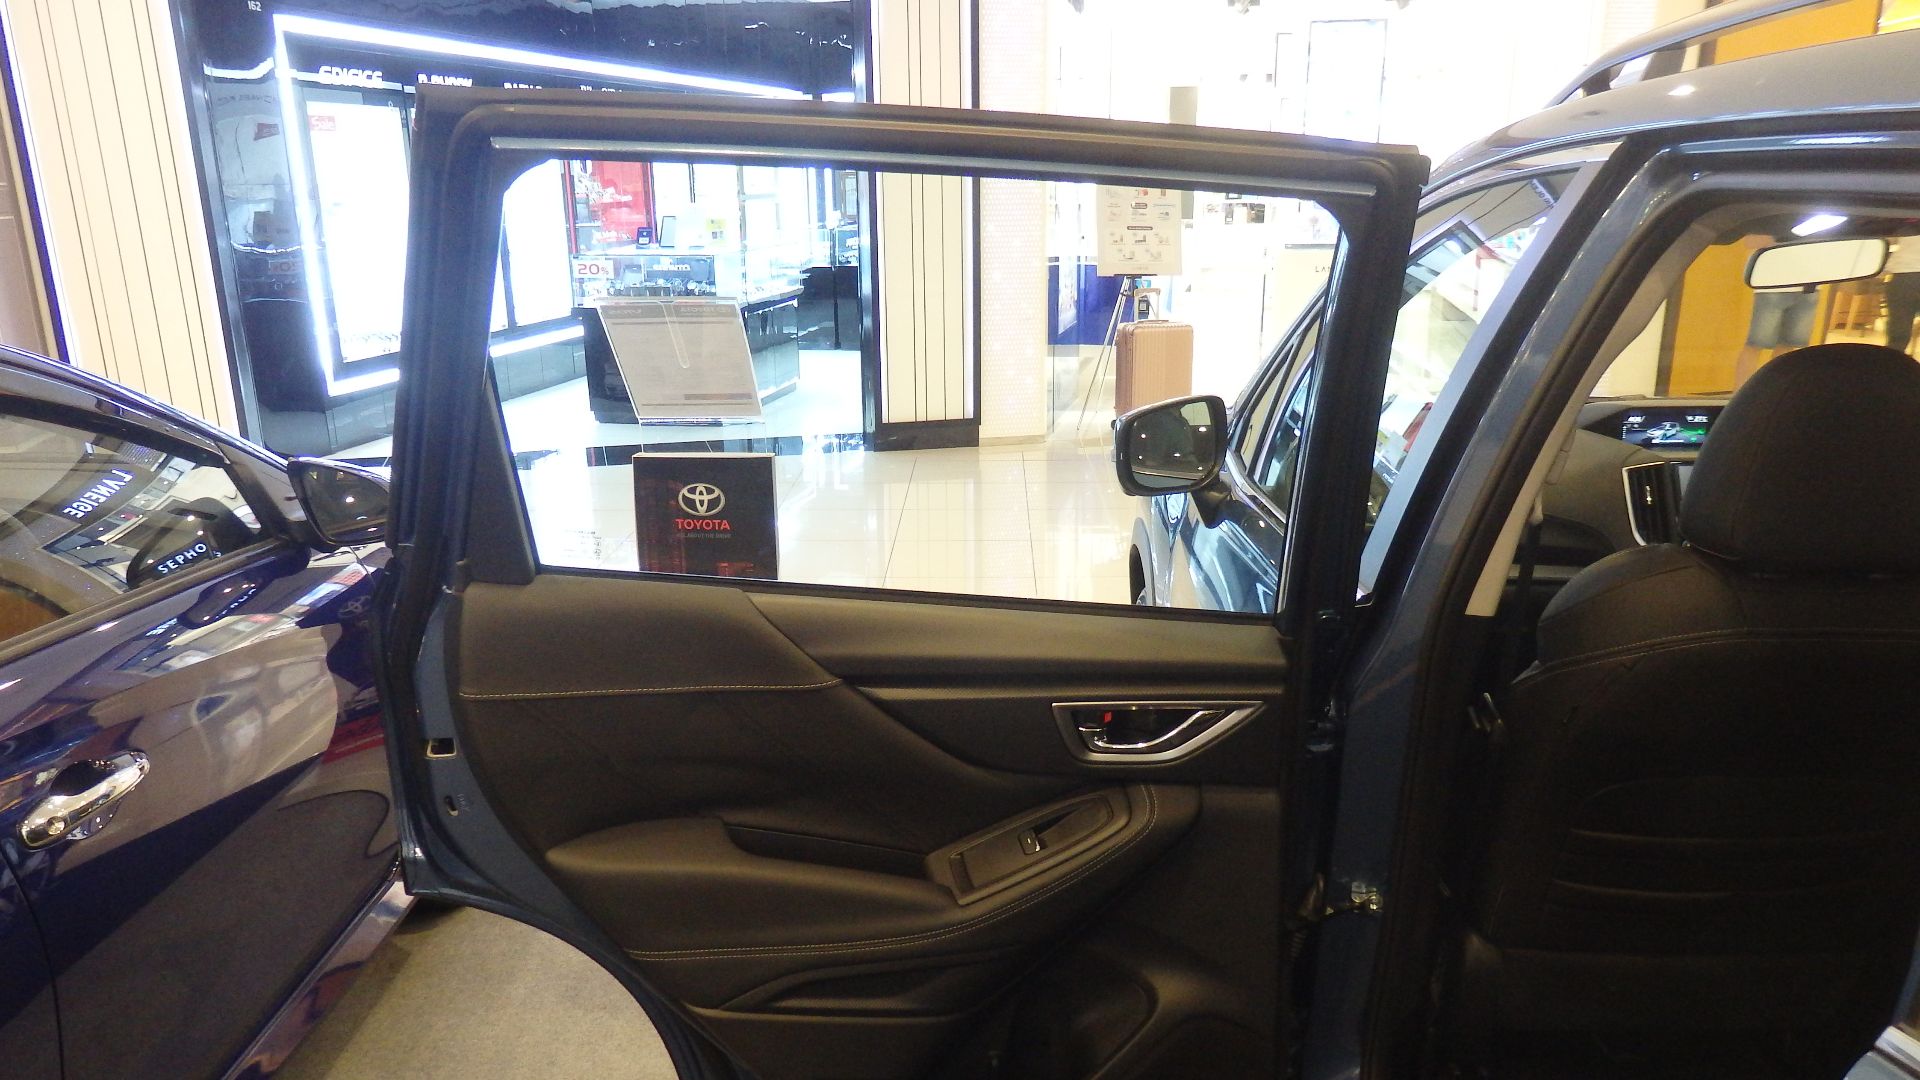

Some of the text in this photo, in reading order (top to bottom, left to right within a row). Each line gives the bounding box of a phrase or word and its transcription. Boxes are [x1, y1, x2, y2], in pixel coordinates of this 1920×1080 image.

[247, 1, 262, 11] 162
[318, 66, 383, 88] EDIFICE
[577, 264, 609, 275] 20%
[675, 519, 730, 530] TOYOTA
